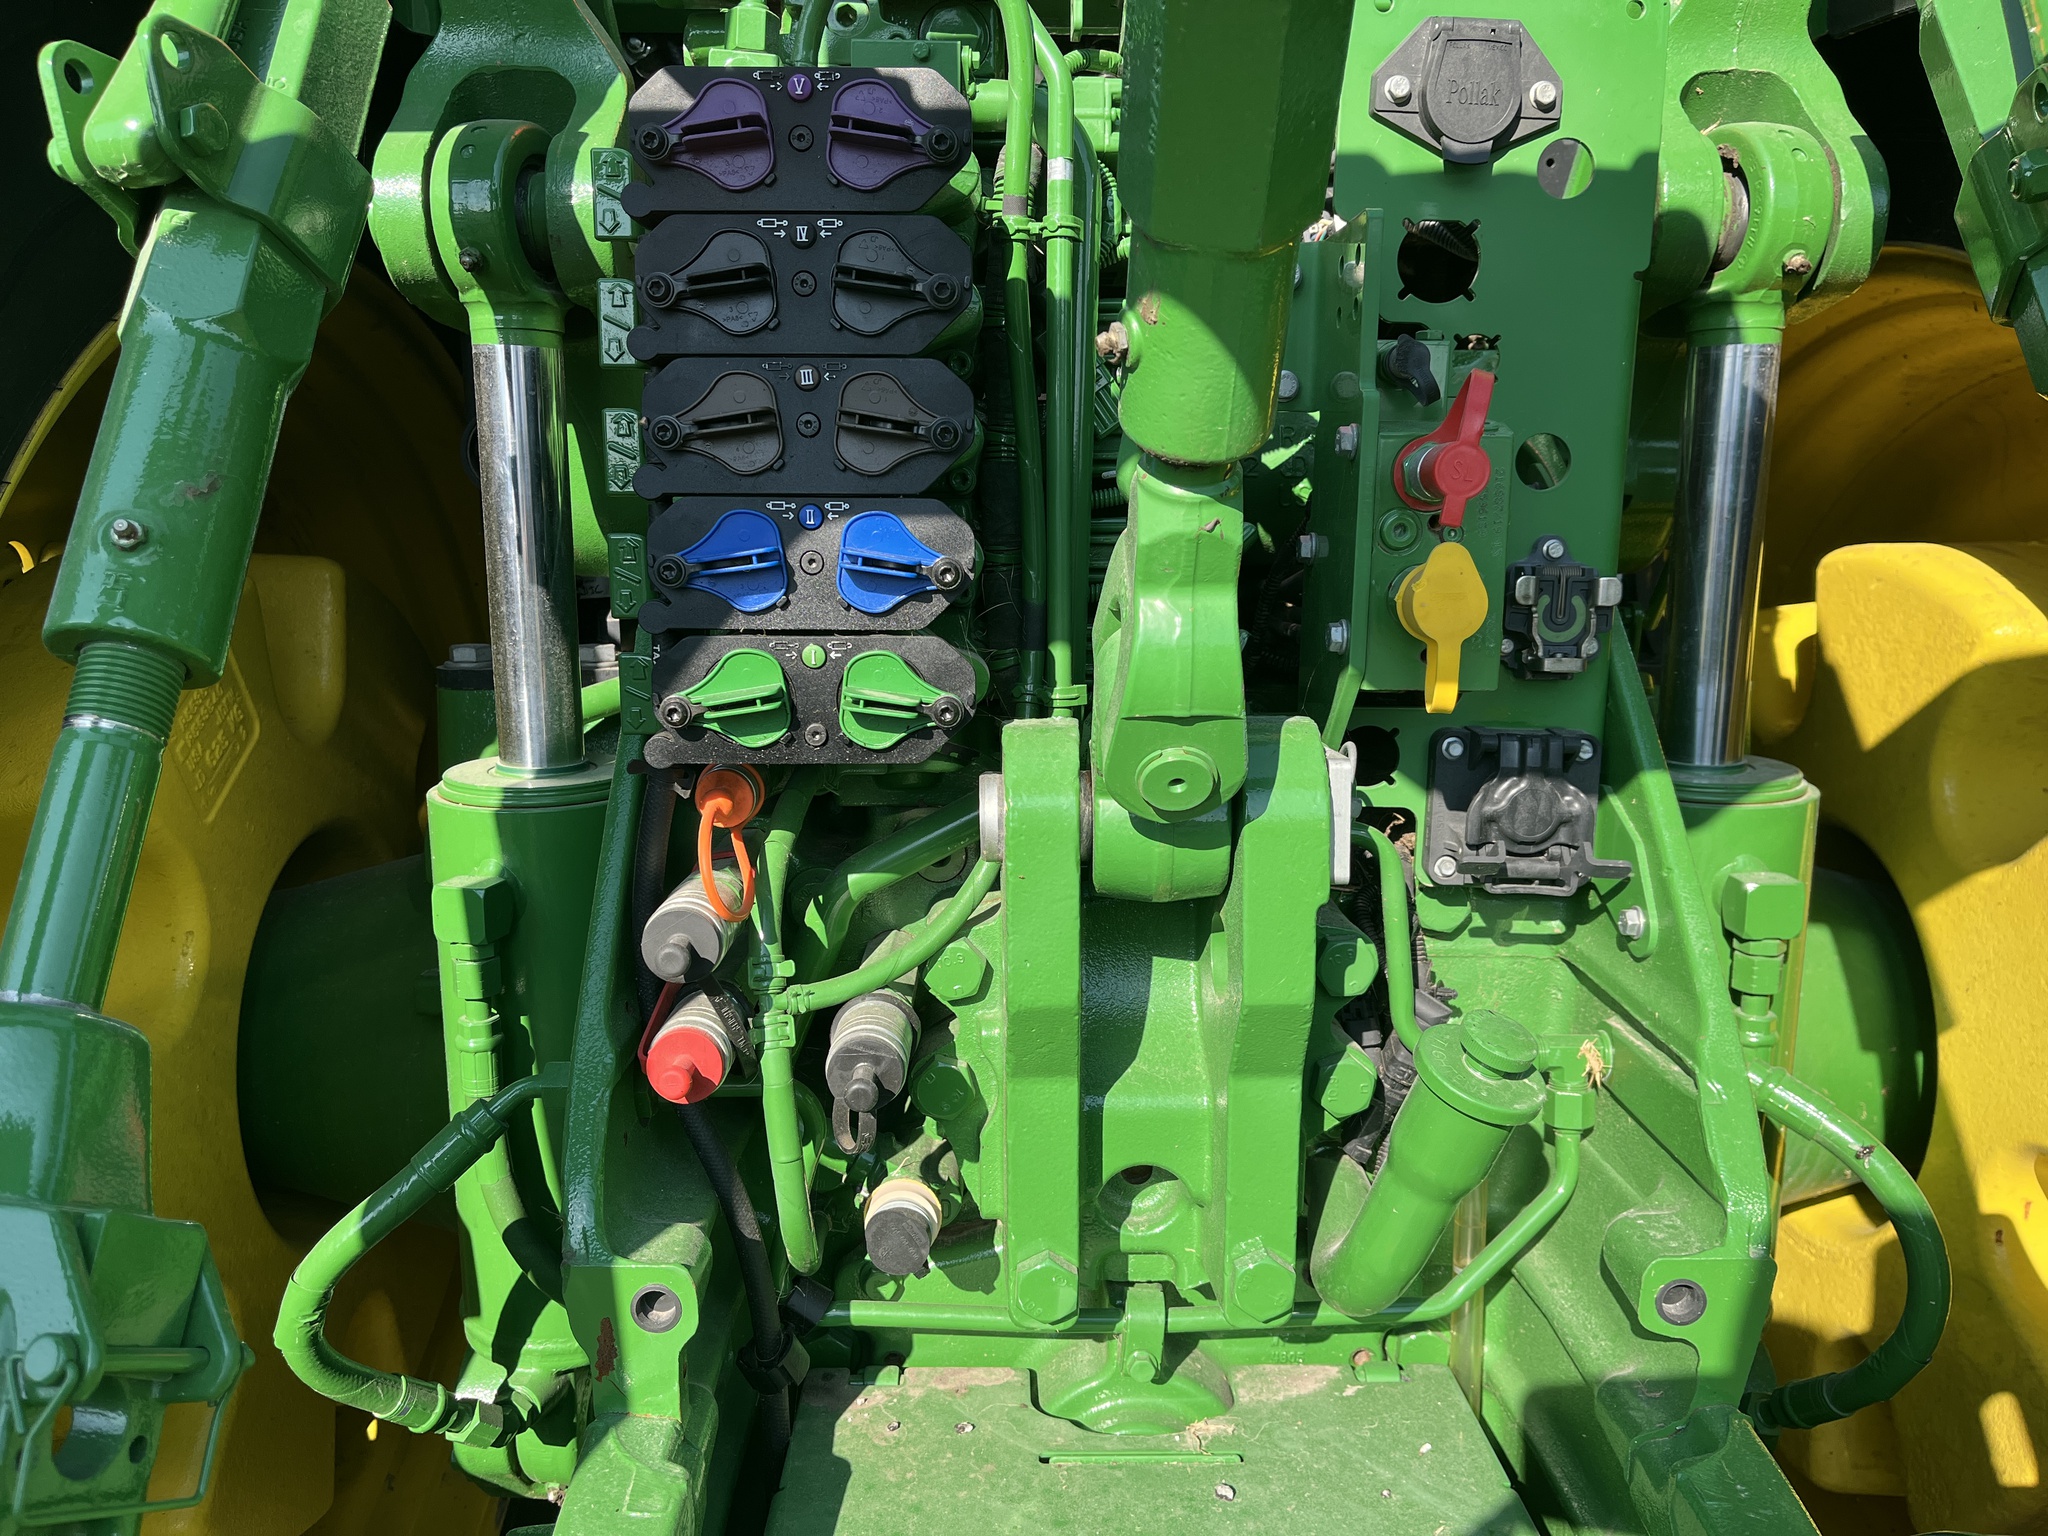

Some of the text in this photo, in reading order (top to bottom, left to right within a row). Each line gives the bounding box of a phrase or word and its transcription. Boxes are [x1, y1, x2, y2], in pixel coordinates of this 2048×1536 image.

[1445, 79, 1502, 107] Pollak
[795, 226, 810, 242] IV
[800, 369, 814, 386] III
[1450, 460, 1473, 482] SL
